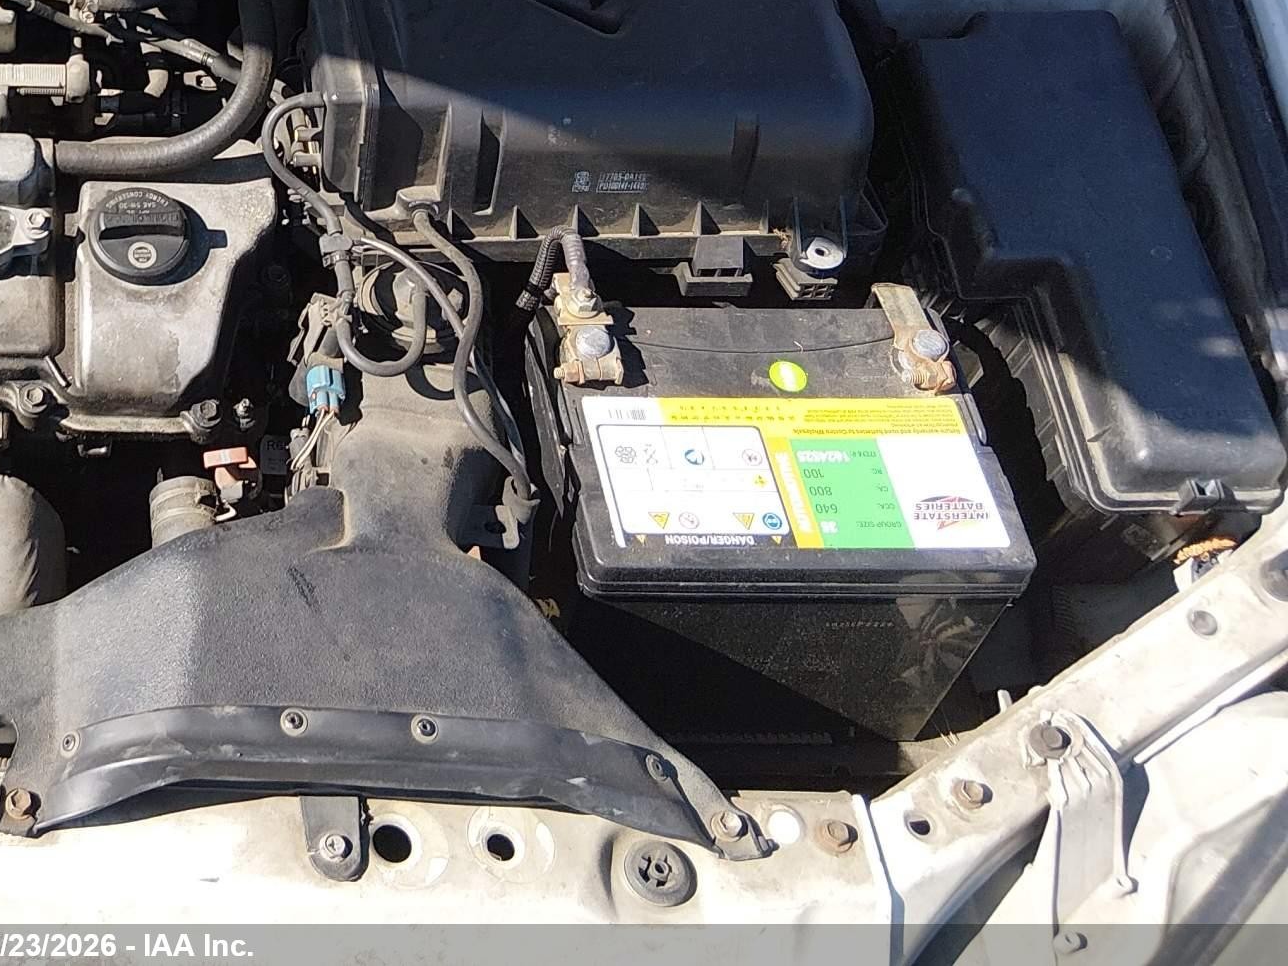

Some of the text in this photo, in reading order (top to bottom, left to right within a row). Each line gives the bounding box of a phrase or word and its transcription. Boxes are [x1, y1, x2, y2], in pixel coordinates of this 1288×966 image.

[145, 192, 169, 207] ENERGY
[143, 201, 157, 209] SAE
[803, 468, 825, 479] 100
[809, 486, 833, 496] 800
[815, 503, 838, 514] 640
[915, 502, 984, 511] BATTERIES
[913, 512, 989, 521] INTERSTATE
[877, 520, 902, 528] GROUP
[664, 534, 755, 546] DANGER/POISON
